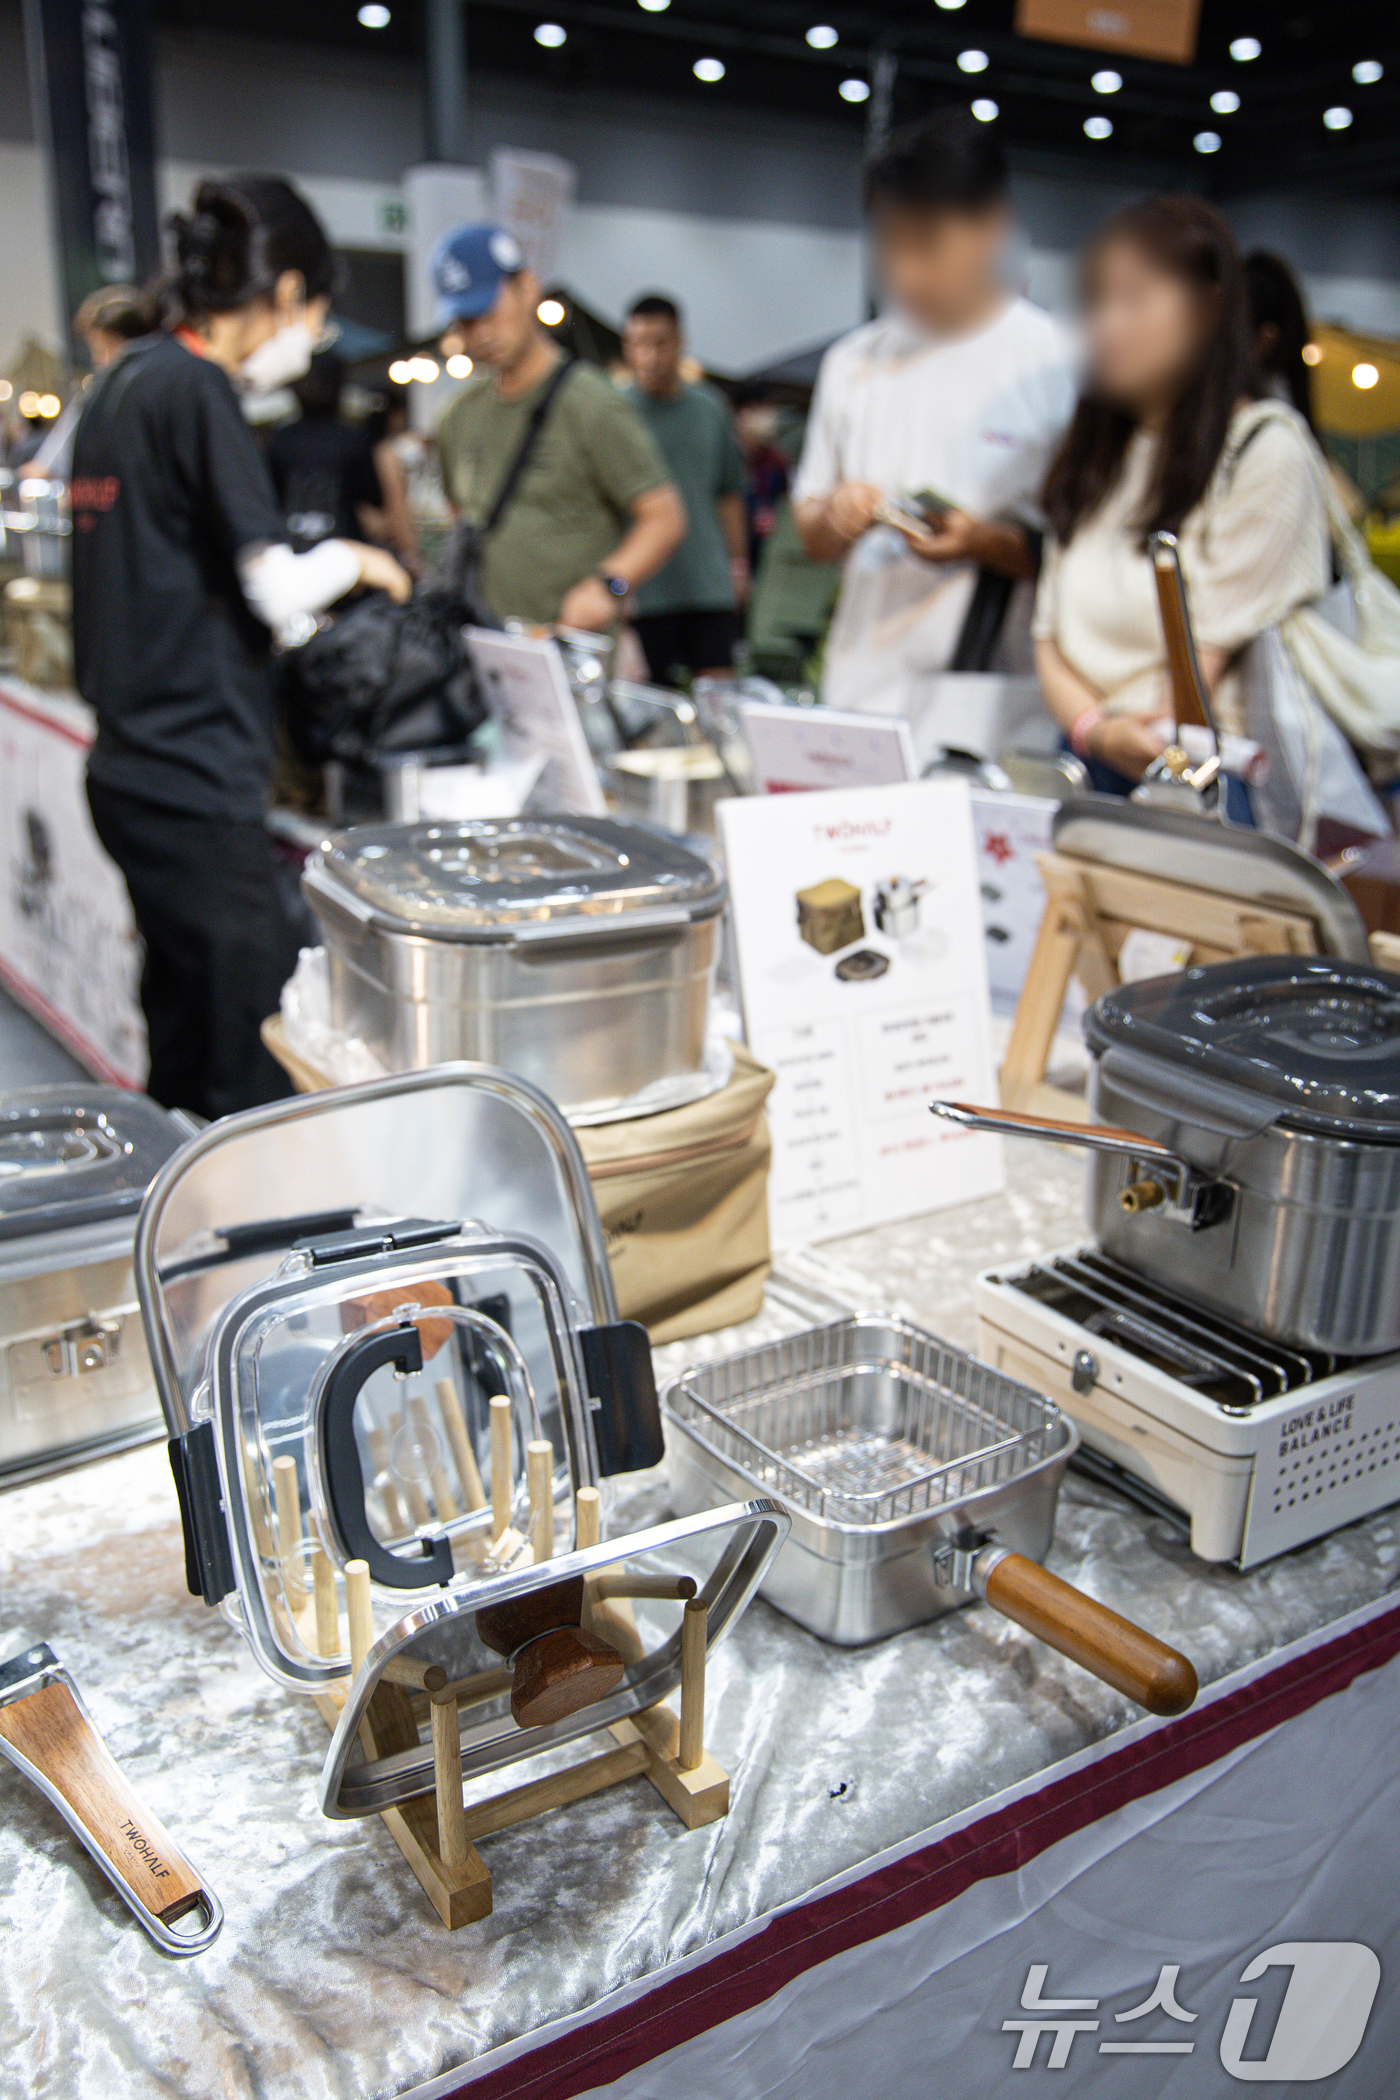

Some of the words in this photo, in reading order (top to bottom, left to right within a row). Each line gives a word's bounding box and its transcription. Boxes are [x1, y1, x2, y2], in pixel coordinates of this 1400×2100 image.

[1278, 1413, 1353, 1458] BALANCE
[1281, 1410, 1314, 1437] LOVE
[1316, 1406, 1326, 1422] &
[1328, 1393, 1355, 1418] LIFE
[120, 1819, 169, 1878] TWOHALF
